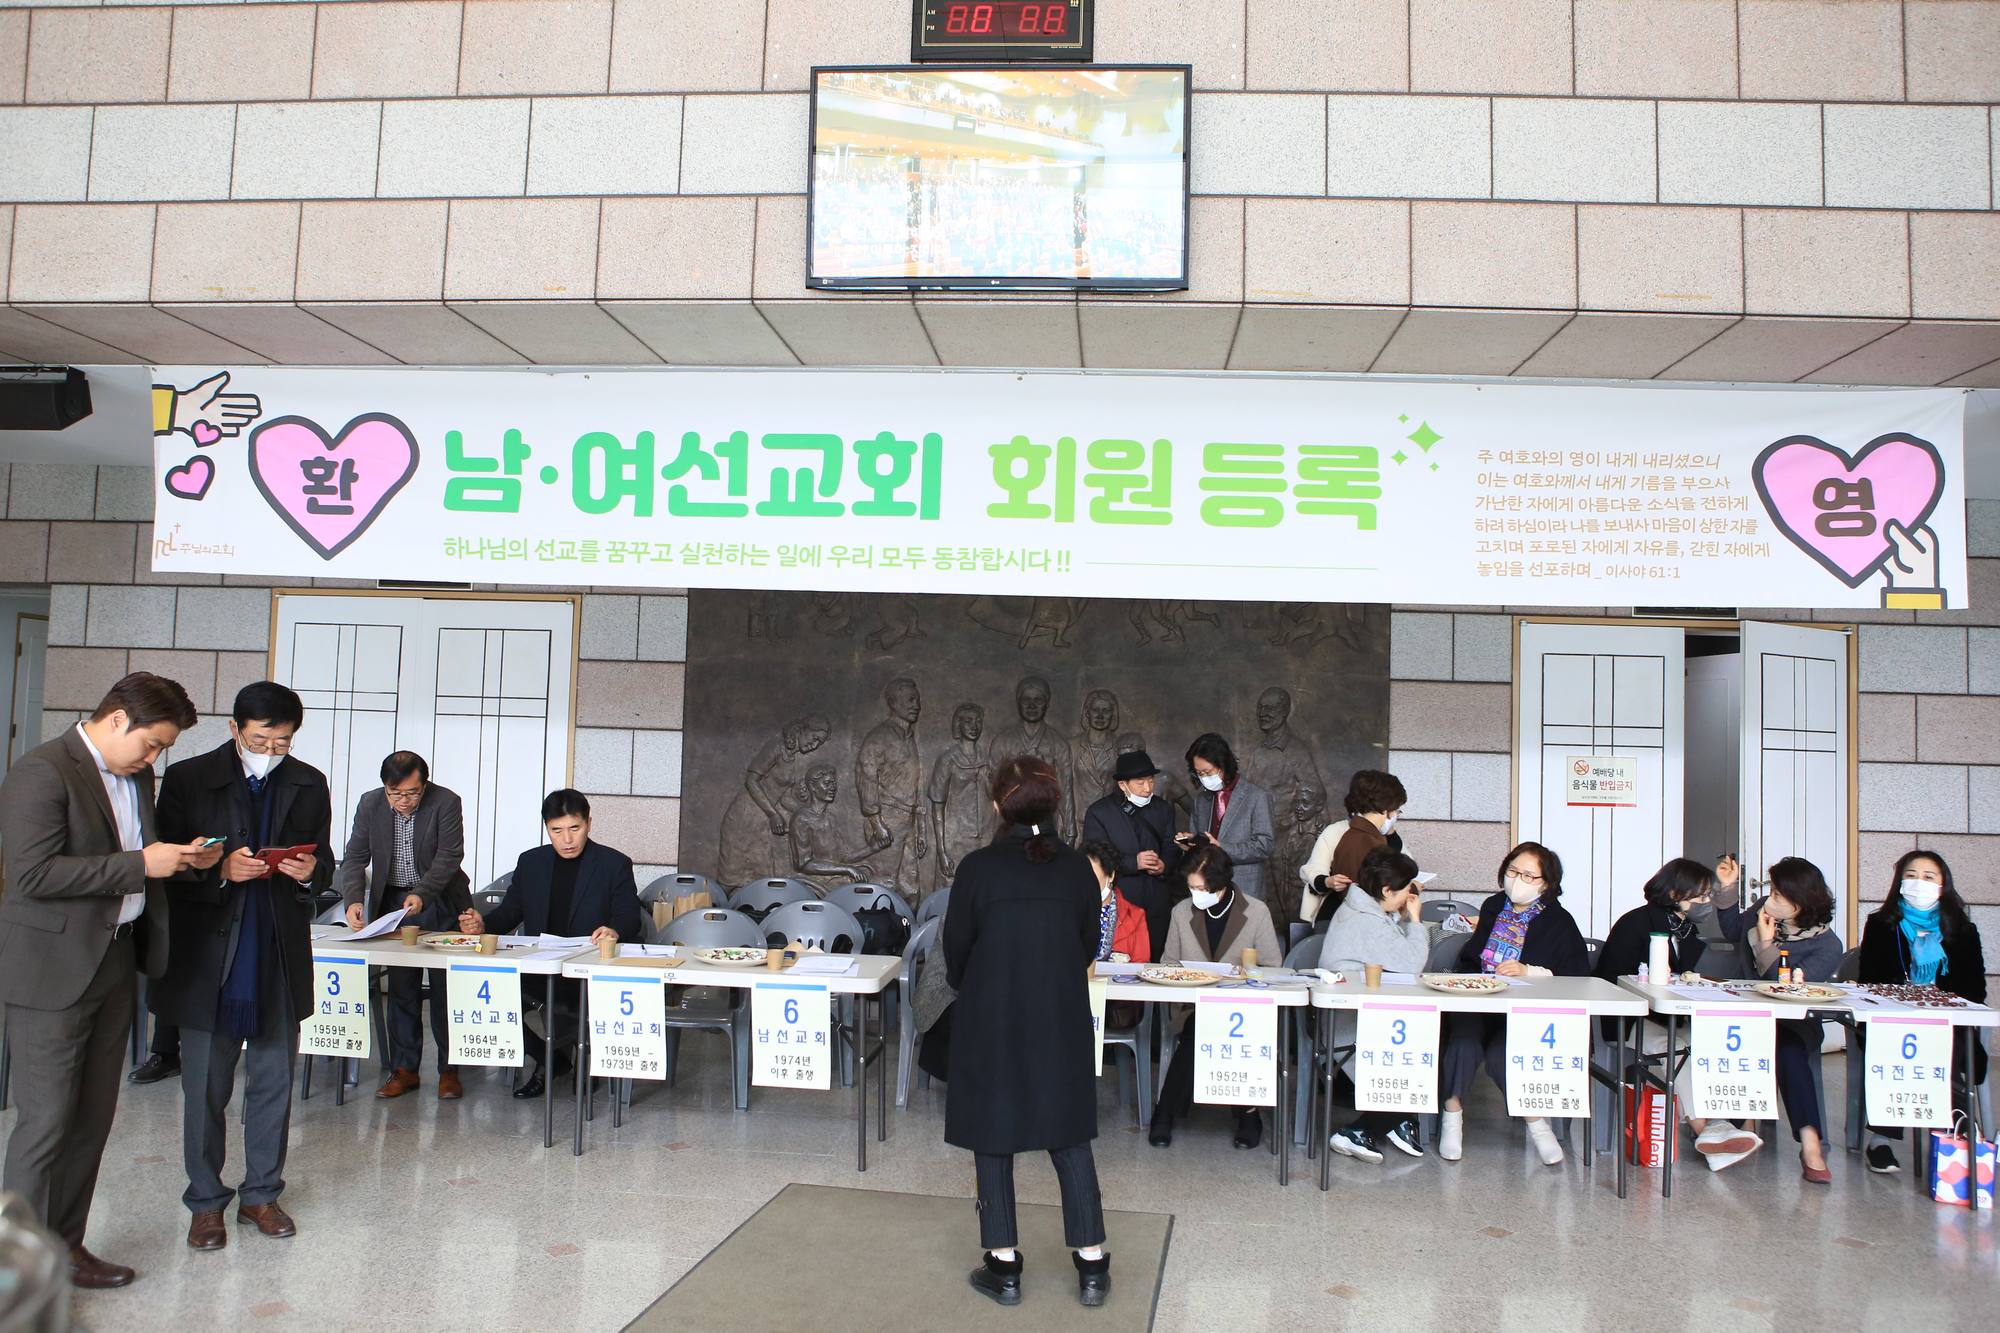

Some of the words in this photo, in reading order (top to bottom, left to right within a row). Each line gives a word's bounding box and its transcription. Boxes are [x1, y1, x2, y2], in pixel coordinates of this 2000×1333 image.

[1477, 449, 1495, 465] 주
[1499, 450, 1563, 466] 여호와의
[1569, 450, 1600, 467] 영이
[1607, 452, 1637, 468] 내게
[1643, 453, 1721, 469] 내리셨으니
[300, 455, 360, 516] 환
[987, 435, 1173, 526] 회원
[1199, 442, 1383, 530] 등록
[1477, 472, 1508, 488] 이는
[1513, 473, 1591, 489] 여호와께서
[1595, 475, 1626, 489] 내게
[1630, 475, 1677, 491] 기름을
[1681, 476, 1730, 490] 부으사
[1475, 495, 1523, 511] 가난한
[1527, 496, 1573, 512] 자에게
[1579, 497, 1643, 512] 아름다운
[1647, 497, 1696, 511] 소식을
[1700, 496, 1748, 511] 전하게
[1812, 478, 1877, 537] 영
[1474, 518, 1504, 533] 하려
[1507, 518, 1567, 534] 하심이라
[1570, 519, 1600, 533] 나를
[1604, 519, 1648, 533] 보내사
[1653, 517, 1696, 533] 마음이
[443, 536, 529, 561] 하나님의
[534, 539, 602, 563] 선교를
[605, 541, 673, 564] 꿈꾸고
[680, 542, 770, 566] 실천하는
[776, 544, 822, 568] 일에
[826, 545, 873, 568] 우리
[879, 547, 927, 569] 모두
[1476, 540, 1524, 554] 고치며
[1529, 540, 1576, 554] 포로된
[1582, 540, 1628, 555] 자에게
[1633, 540, 1685, 557] 자유를,
[1689, 541, 1719, 557] 갇힌
[1724, 542, 1770, 558] 자에게
[1477, 560, 1524, 577] 놓임을
[1606, 565, 1646, 578] 이사야
[1649, 567, 1680, 578] 61:1
[1592, 768, 1615, 777] 예배당
[1616, 768, 1624, 777] 내
[1572, 780, 1598, 791] 음식물
[1600, 780, 1632, 791] 반입금지
[327, 971, 341, 996] 3
[477, 980, 492, 1005] 4
[620, 991, 634, 1016] 5
[784, 999, 799, 1025] 6
[313, 1024, 347, 1036] 1959년
[1229, 1012, 1244, 1038] 2
[1391, 1019, 1407, 1045] 3
[462, 1034, 498, 1046] 1964년
[1540, 1023, 1556, 1049] 4
[1726, 1025, 1741, 1052] 5
[309, 1037, 340, 1049] 1963년
[346, 1039, 363, 1052] 출생
[604, 1046, 641, 1057] 1969년
[1901, 1033, 1917, 1060] 6
[458, 1047, 492, 1059] 1968년
[498, 1048, 516, 1060] 출생
[774, 1055, 811, 1067] 1974년
[600, 1059, 634, 1071] 1973년
[640, 1060, 659, 1072] 출생
[770, 1068, 788, 1079] 이후
[795, 1070, 814, 1081] 출생
[1210, 1071, 1248, 1082] 1952년
[1205, 1085, 1240, 1097] 1955년
[1248, 1086, 1267, 1098] 출생
[1370, 1078, 1409, 1090] 1956년
[1522, 1084, 1560, 1095] 1960년
[1708, 1085, 1747, 1096] 1966년
[1366, 1092, 1402, 1104] 1959년
[1409, 1093, 1428, 1105] 출생
[1518, 1097, 1554, 1109] 1965년
[1561, 1098, 1580, 1110] 출생
[1704, 1099, 1741, 1111] 1971년
[1748, 1100, 1768, 1112] 출생
[1888, 1093, 1929, 1104] 1972년
[1885, 1106, 1904, 1118] 이후
[1913, 1107, 1933, 1120] 출생
